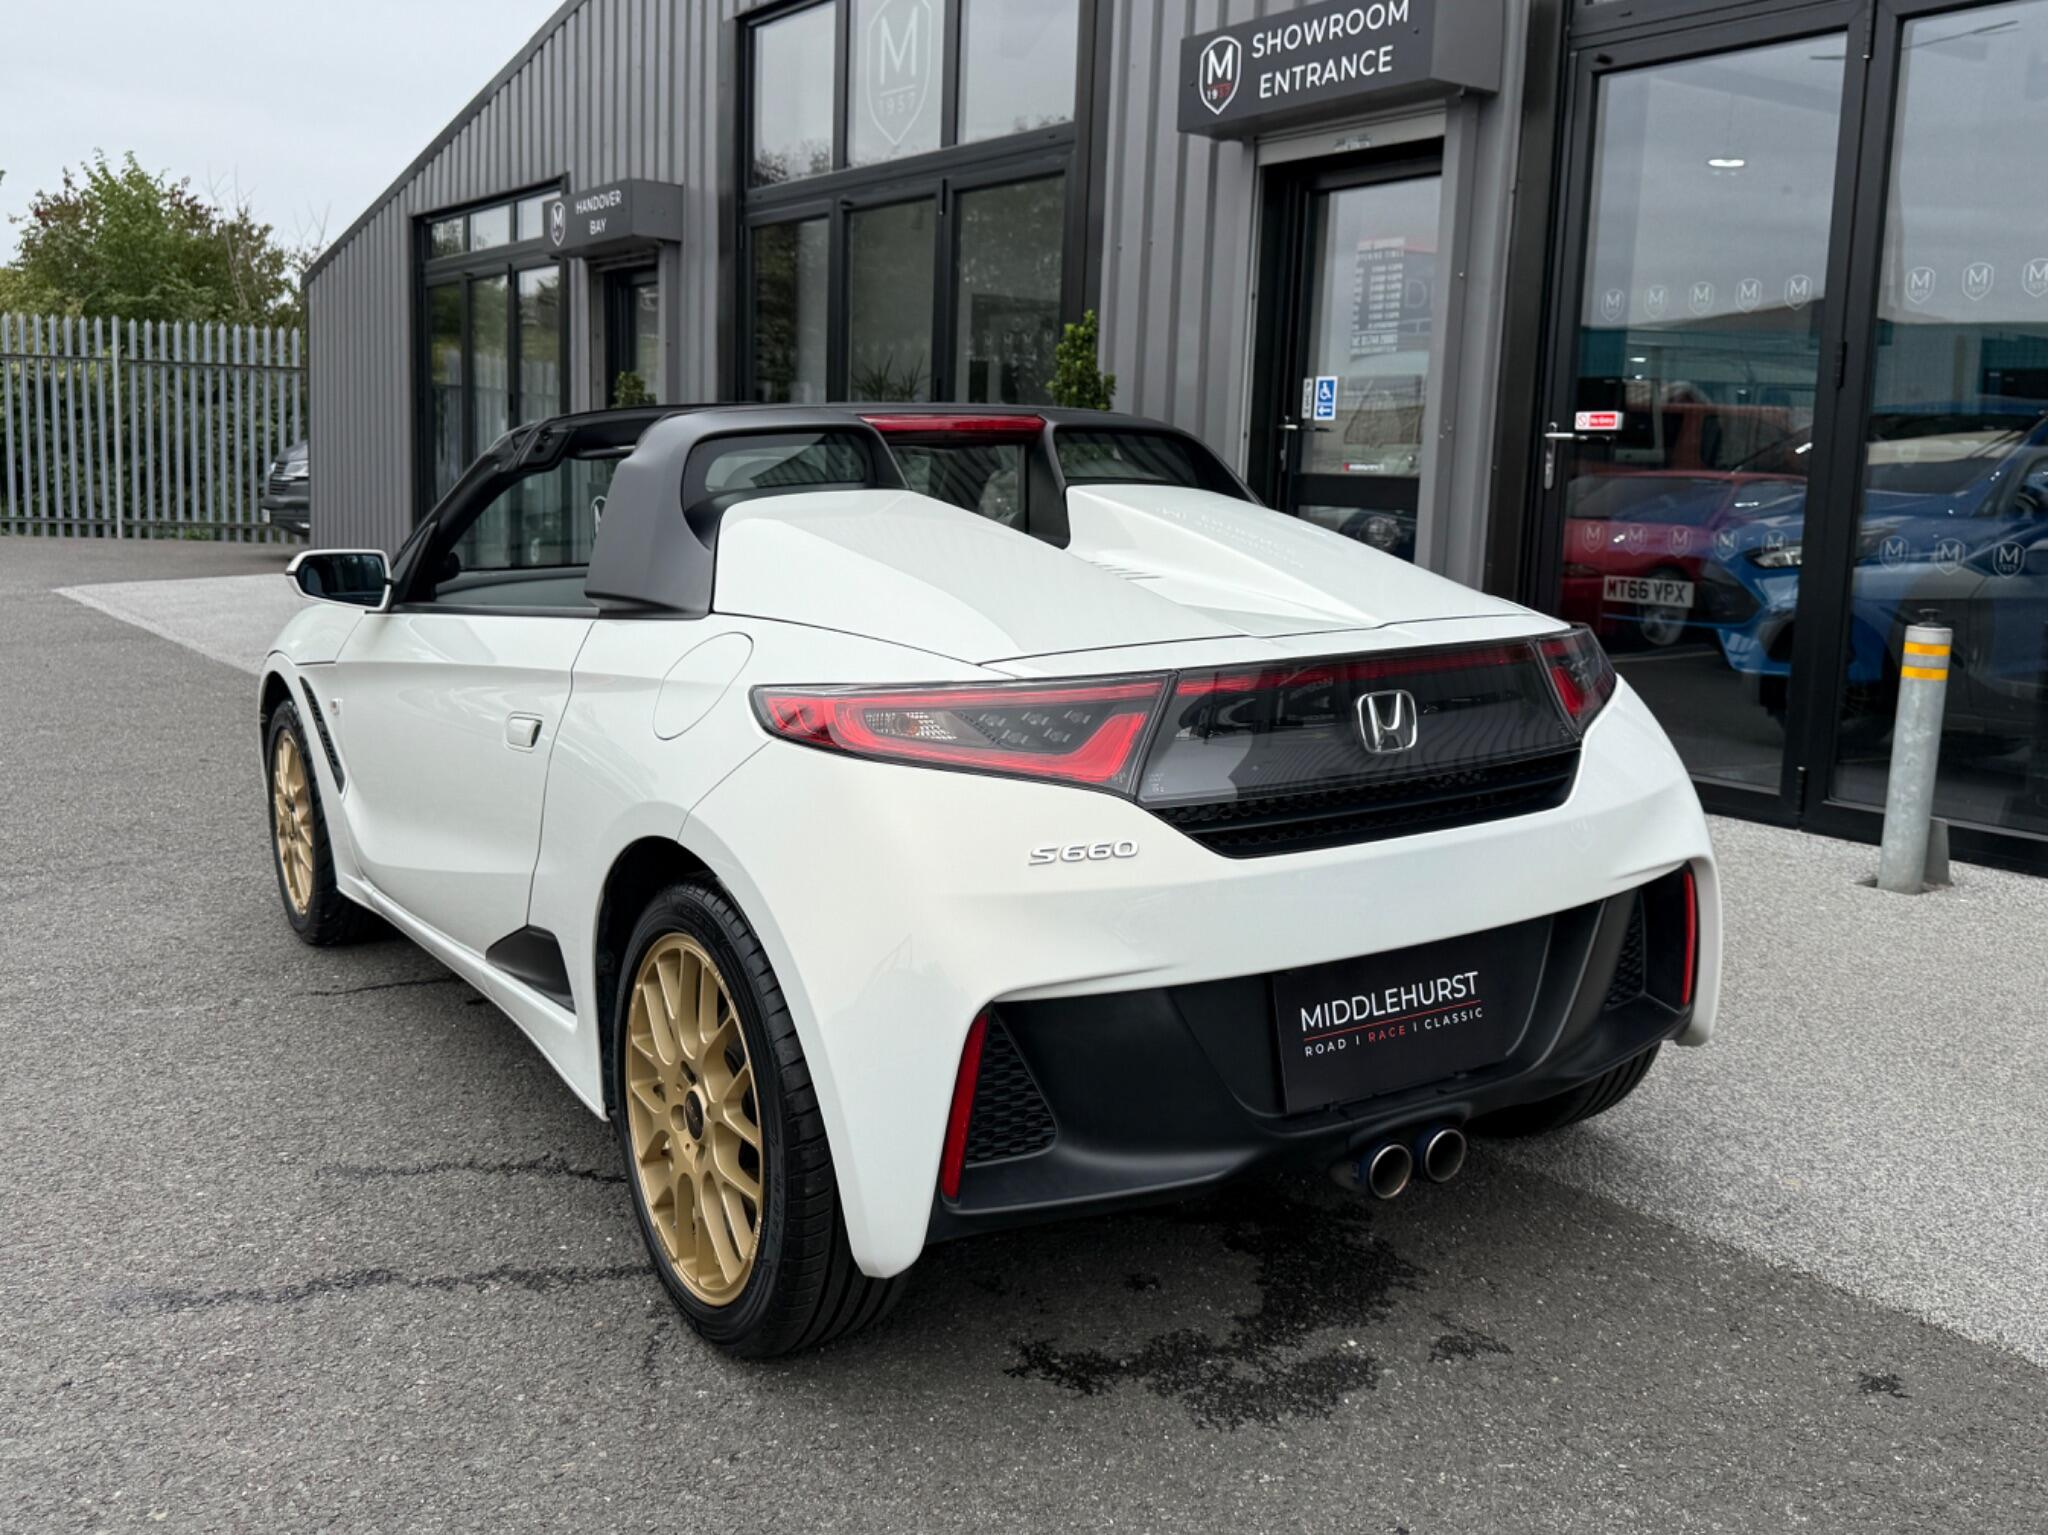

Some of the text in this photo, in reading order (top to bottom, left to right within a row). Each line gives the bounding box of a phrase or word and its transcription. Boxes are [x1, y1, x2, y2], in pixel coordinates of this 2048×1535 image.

[1251, 0, 1409, 59] SHOWROOM
[1207, 43, 1233, 85] M
[1259, 45, 1394, 99] ENTRANCE
[576, 189, 622, 215] HANDOVER
[590, 218, 606, 235] BAY
[1999, 547, 2018, 565] M
[1607, 580, 1687, 603] MT66 VPX
[1028, 839, 1139, 866] S660
[1301, 971, 1479, 1032] MIDDLEHURST
[1305, 1038, 1347, 1057] ROAD
[1368, 1026, 1406, 1043] RACE
[1424, 1007, 1484, 1031] CLASSIC
